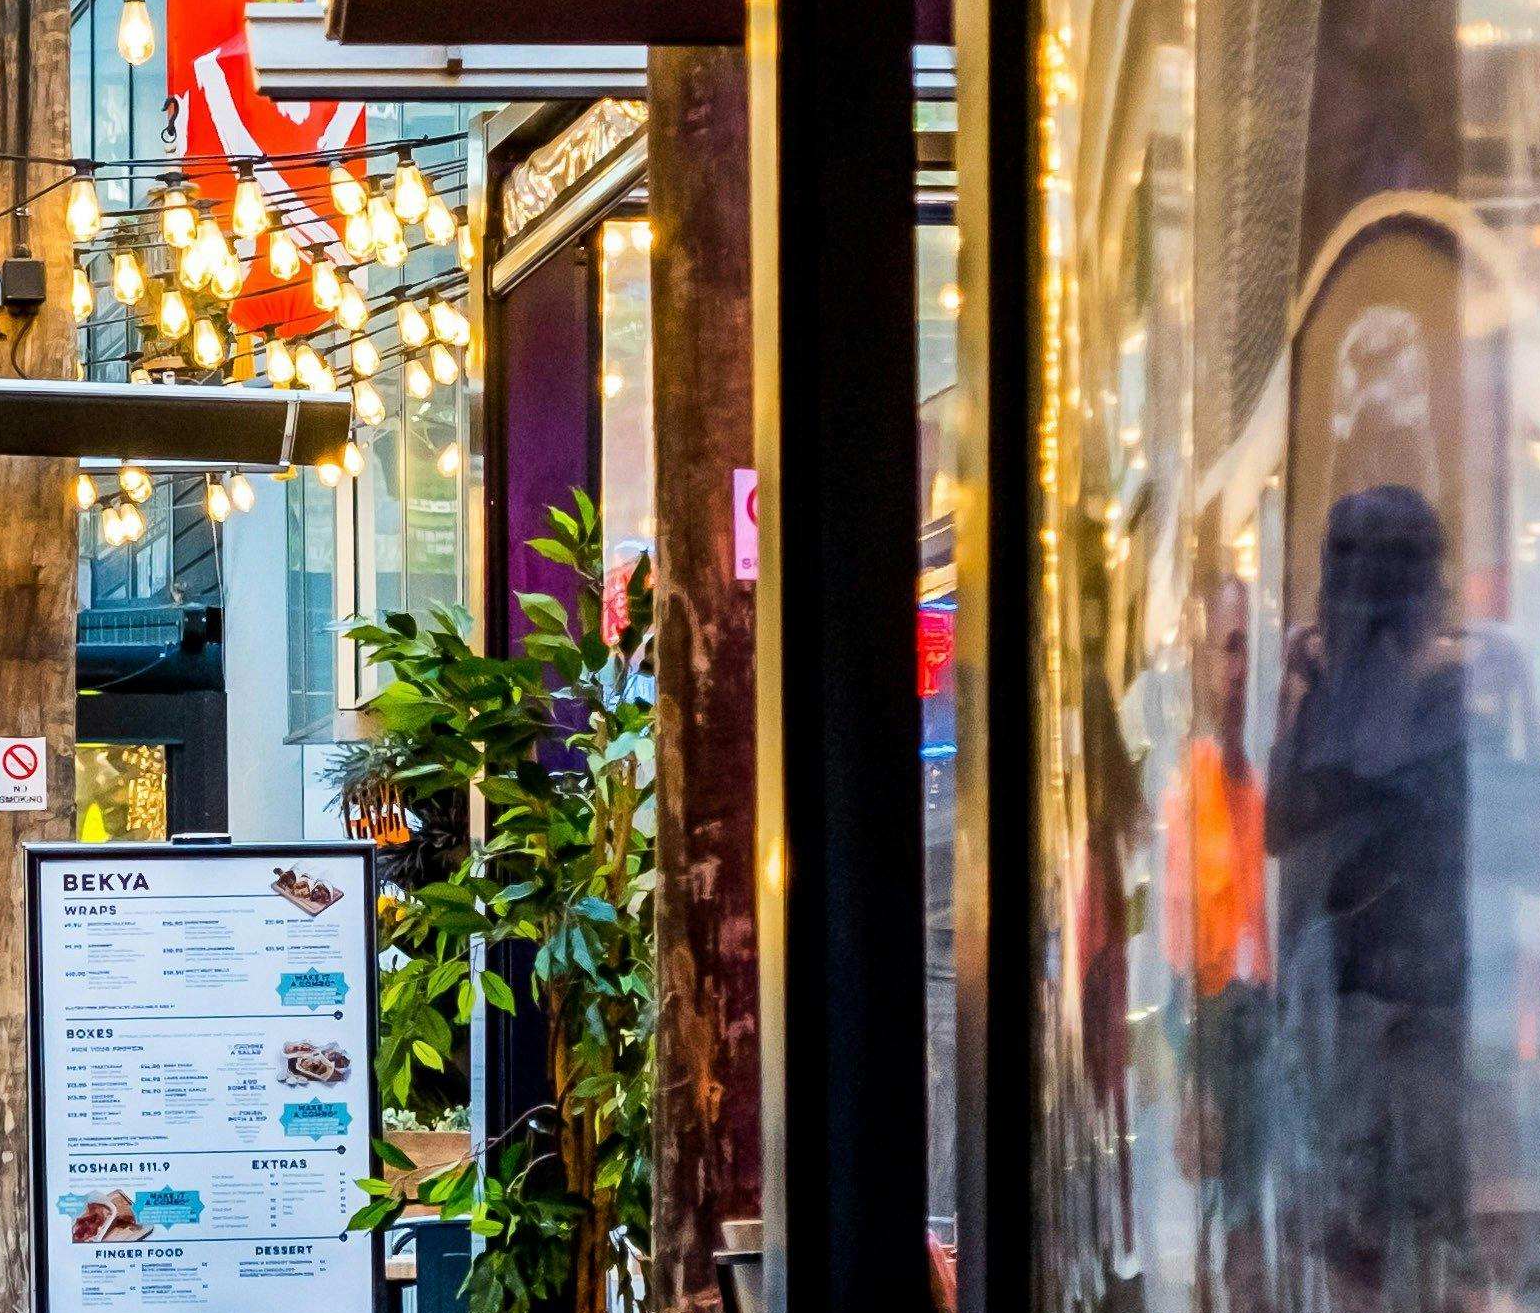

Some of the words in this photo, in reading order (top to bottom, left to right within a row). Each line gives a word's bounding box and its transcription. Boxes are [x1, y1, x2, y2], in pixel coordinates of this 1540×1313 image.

[63, 872, 150, 892] BEKYA
[64, 904, 117, 916] WRAPS
[66, 1028, 114, 1039] BOXES
[69, 1162, 133, 1174] KOSHARI
[252, 1158, 308, 1169] EXTRAS
[95, 1248, 142, 1259] FINGER
[147, 1247, 184, 1258] FOOD
[255, 1245, 313, 1256] DESSERT
